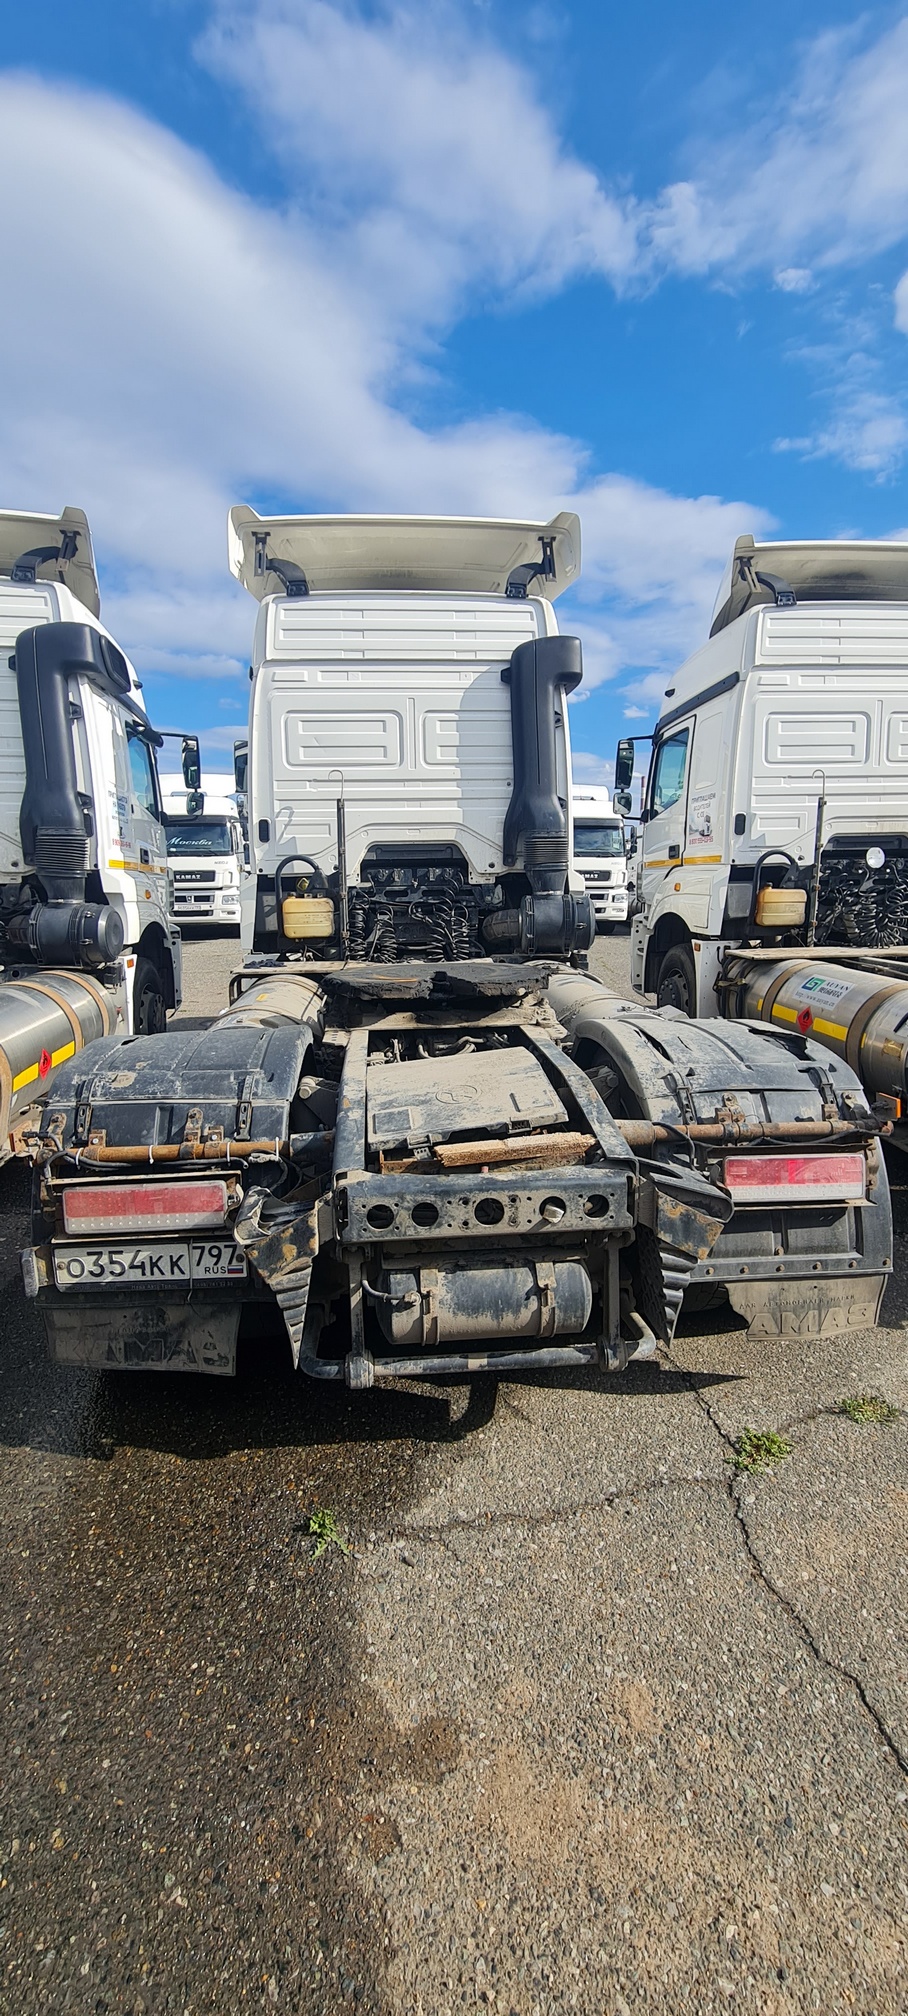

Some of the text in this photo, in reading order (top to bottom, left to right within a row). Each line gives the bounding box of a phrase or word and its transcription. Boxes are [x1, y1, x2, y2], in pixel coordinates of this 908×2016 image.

[166, 836, 213, 846] Москва
[66, 1244, 239, 1279] О354КК 797
[204, 1265, 227, 1275] RUS
